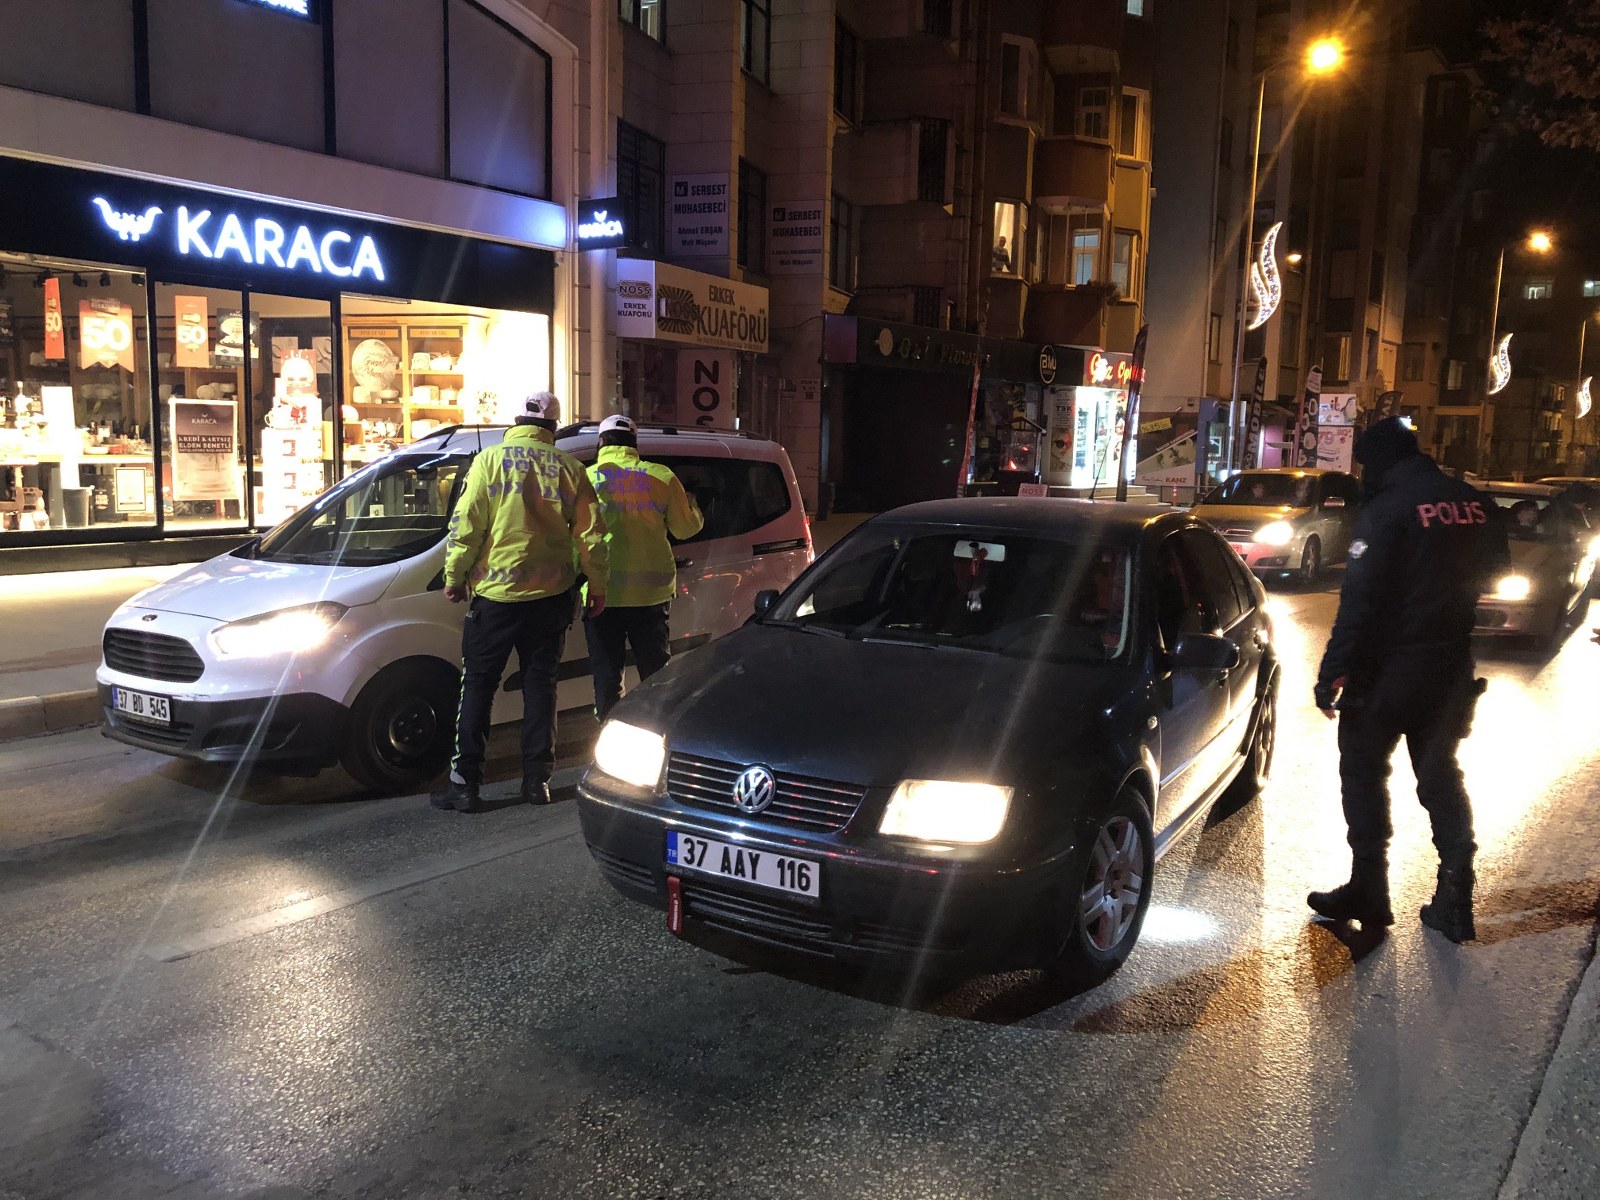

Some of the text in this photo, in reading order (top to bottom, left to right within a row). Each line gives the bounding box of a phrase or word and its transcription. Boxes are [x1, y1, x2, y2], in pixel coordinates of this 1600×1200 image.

[691, 184, 726, 196] SERBEST
[674, 200, 726, 214] MUHASEBECİ
[788, 210, 822, 220] SERBEST
[700, 226, 723, 236] ERŞAN
[177, 205, 385, 281] KARACA
[618, 285, 651, 295] NOSS
[709, 285, 735, 306] ERKEK
[623, 302, 647, 310] ERKEK
[83, 316, 132, 351] 50
[177, 325, 207, 345] 50
[695, 306, 767, 345] KUAFÖRÜ
[118, 690, 167, 718] 37 BD 545
[683, 837, 708, 867] 37
[720, 846, 760, 880] AAY
[777, 857, 812, 892] 116
